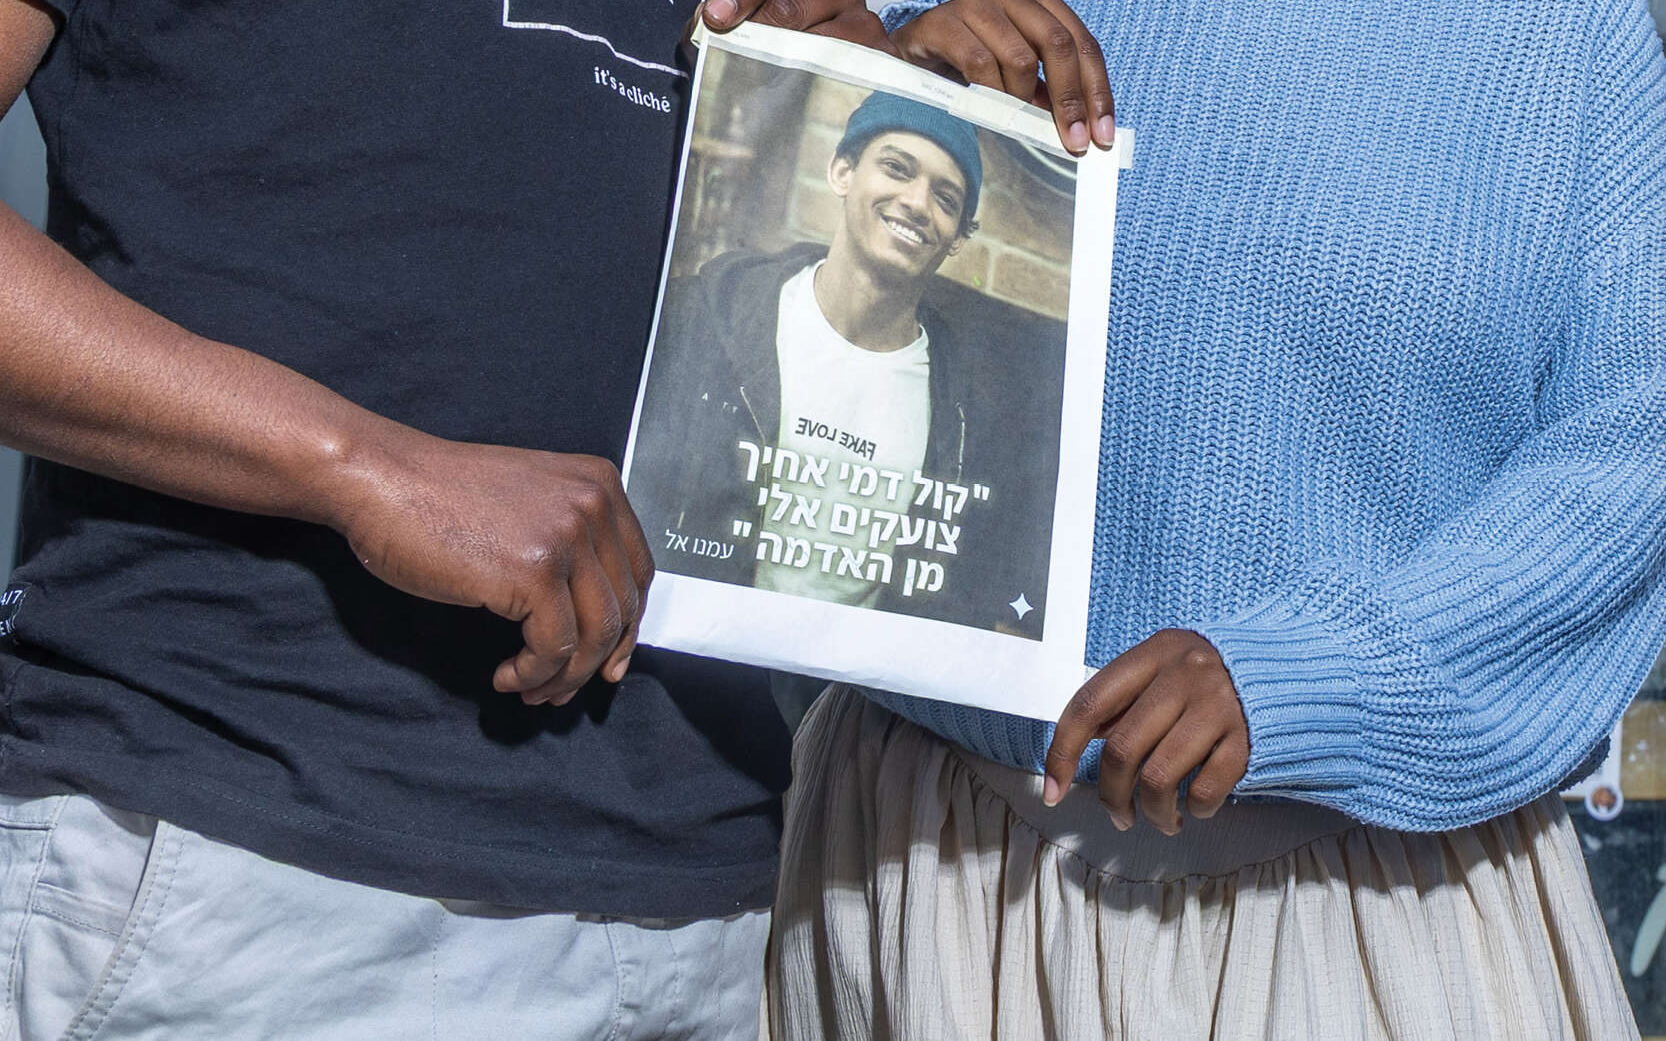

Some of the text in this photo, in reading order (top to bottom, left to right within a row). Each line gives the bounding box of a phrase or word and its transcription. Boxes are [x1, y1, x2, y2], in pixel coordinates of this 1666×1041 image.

[593, 66, 672, 113] it's a cliché
[738, 440, 991, 521] "קול דמי אחיך
[757, 483, 962, 555] צועקים אלי
[665, 528, 735, 560] עמנו אל
[903, 557, 945, 597] מן
